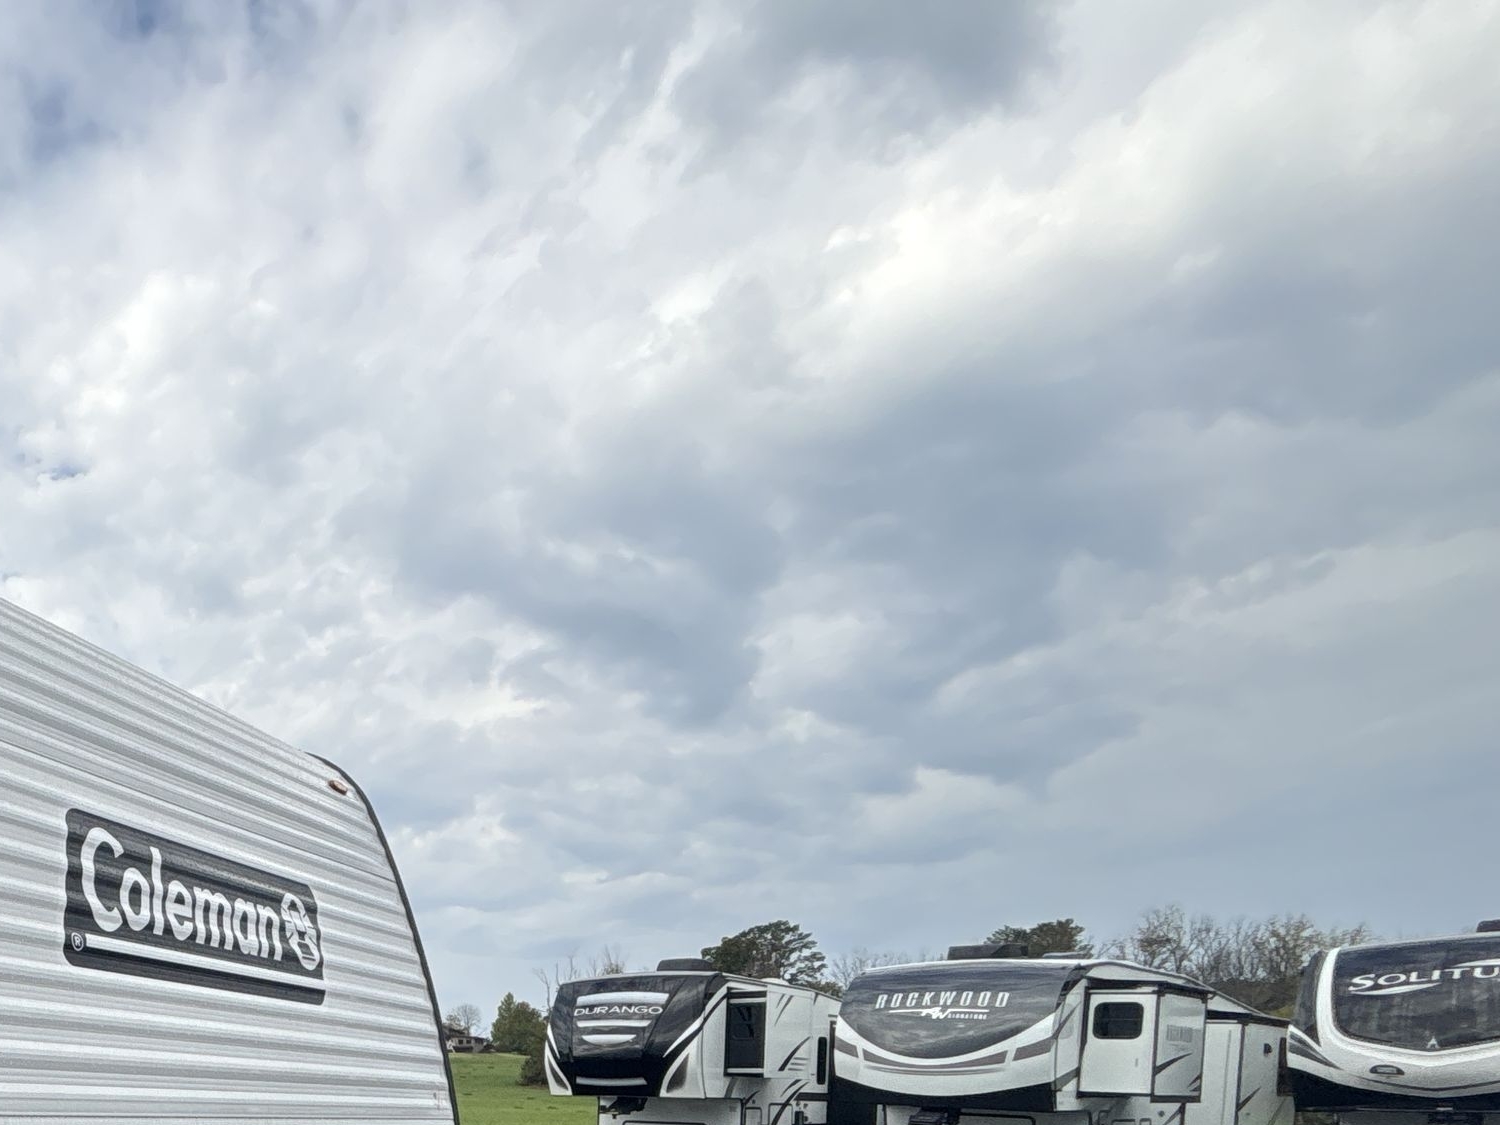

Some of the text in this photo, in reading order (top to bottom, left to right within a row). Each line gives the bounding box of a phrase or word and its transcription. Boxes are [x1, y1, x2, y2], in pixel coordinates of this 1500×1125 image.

[80, 827, 282, 961] Coleman
[875, 991, 1010, 1009] ROCKWOOD
[574, 1005, 664, 1017] DURANGO
